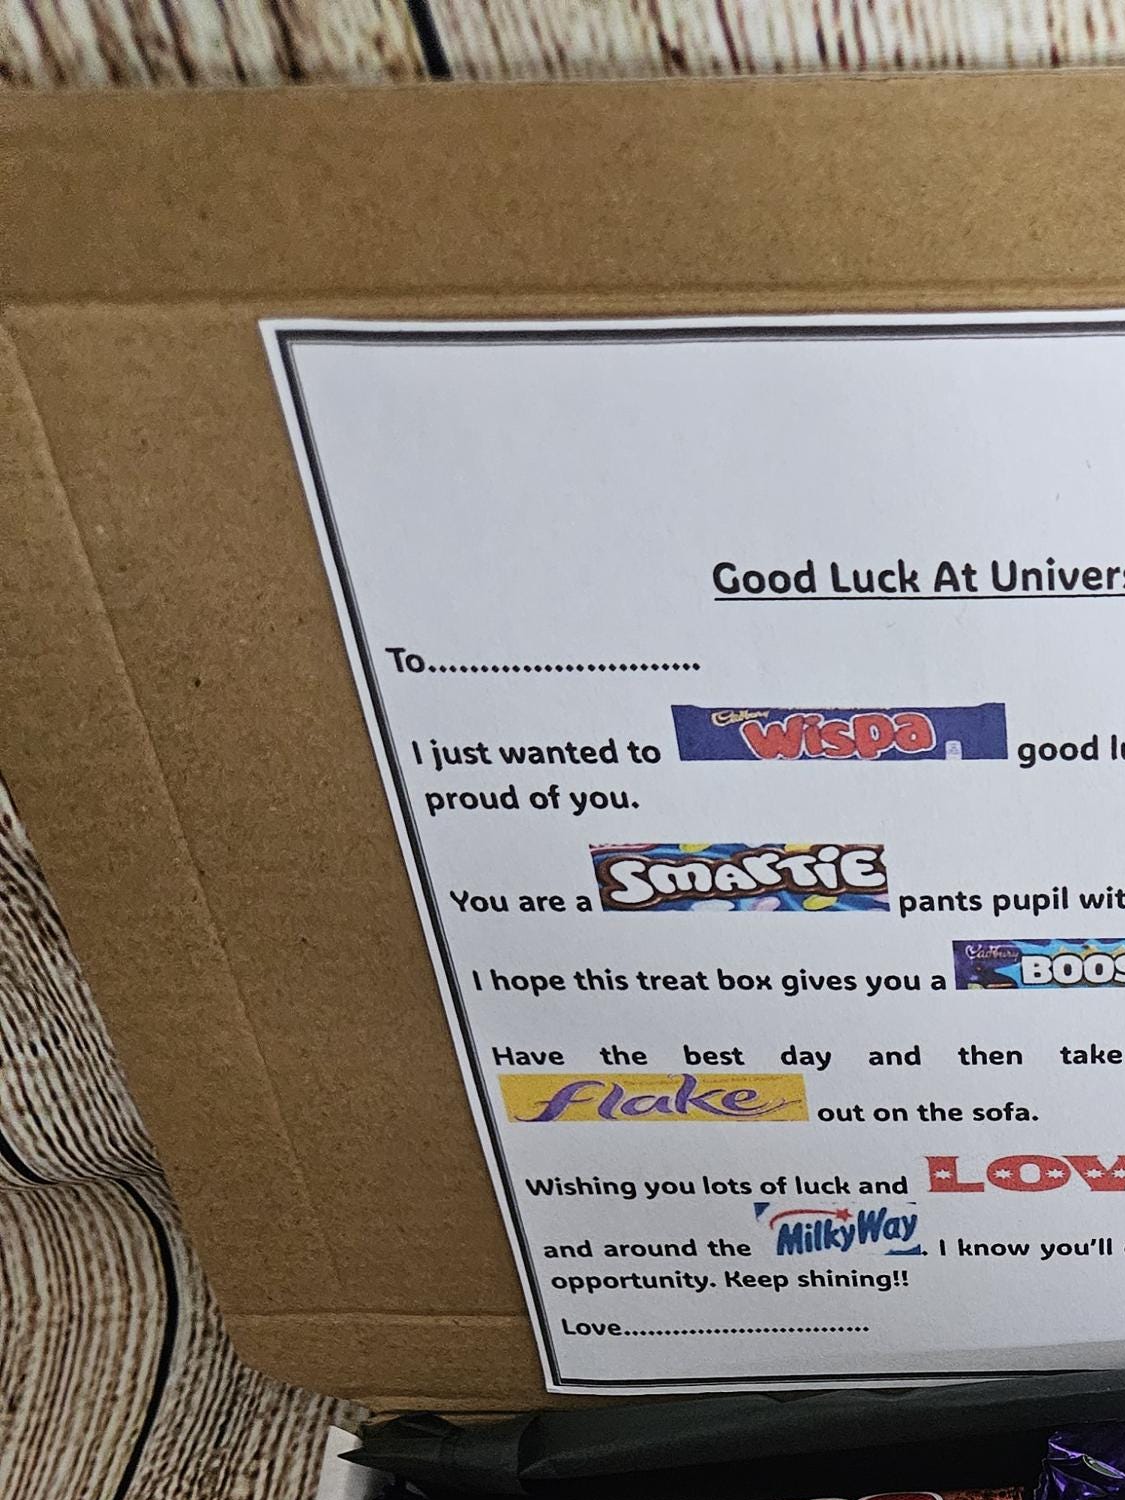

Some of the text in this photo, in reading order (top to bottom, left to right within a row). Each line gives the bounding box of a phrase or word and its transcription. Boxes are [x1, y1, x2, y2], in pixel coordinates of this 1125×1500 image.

[712, 558, 817, 595] Good
[830, 558, 921, 594] Luck
[933, 560, 979, 593] At
[411, 740, 423, 765] I
[429, 738, 493, 772] just
[498, 737, 620, 765] wanted
[626, 740, 662, 765] to
[1017, 733, 1100, 770] good
[424, 783, 640, 818] proud of you.
[449, 889, 510, 913] You
[518, 895, 567, 913] are
[575, 895, 593, 913] a
[898, 890, 983, 919] pants
[992, 885, 1069, 918] pupil
[471, 969, 483, 992] I
[489, 968, 567, 998] hope
[572, 967, 629, 991] this
[635, 970, 710, 992] treat
[716, 967, 773, 991] box
[781, 968, 858, 997] gives
[865, 974, 921, 998] you
[930, 974, 947, 991] a
[491, 1046, 565, 1066] Have
[599, 1044, 648, 1066] the
[682, 1043, 746, 1066] best
[780, 1044, 832, 1072] day
[868, 1044, 922, 1067] and
[957, 1044, 1023, 1066] then
[1059, 1042, 1123, 1065] take
[817, 1104, 866, 1122] out
[872, 1107, 909, 1122] on
[916, 1101, 964, 1122] the
[972, 1101, 1040, 1122] sofa.
[524, 1175, 637, 1201] Wishing
[643, 1180, 696, 1200] you
[702, 1175, 753, 1195] lots
[759, 1175, 788, 1195] of
[794, 1175, 851, 1195] luck
[858, 1175, 909, 1195] and
[543, 1239, 594, 1259] and
[603, 1237, 698, 1258] around
[706, 1237, 752, 1257] the
[939, 1238, 947, 1257] I
[957, 1237, 1030, 1257] know
[1040, 1237, 1113, 1261] you’ll
[550, 1268, 910, 1295] opportunity. Keep shining!!
